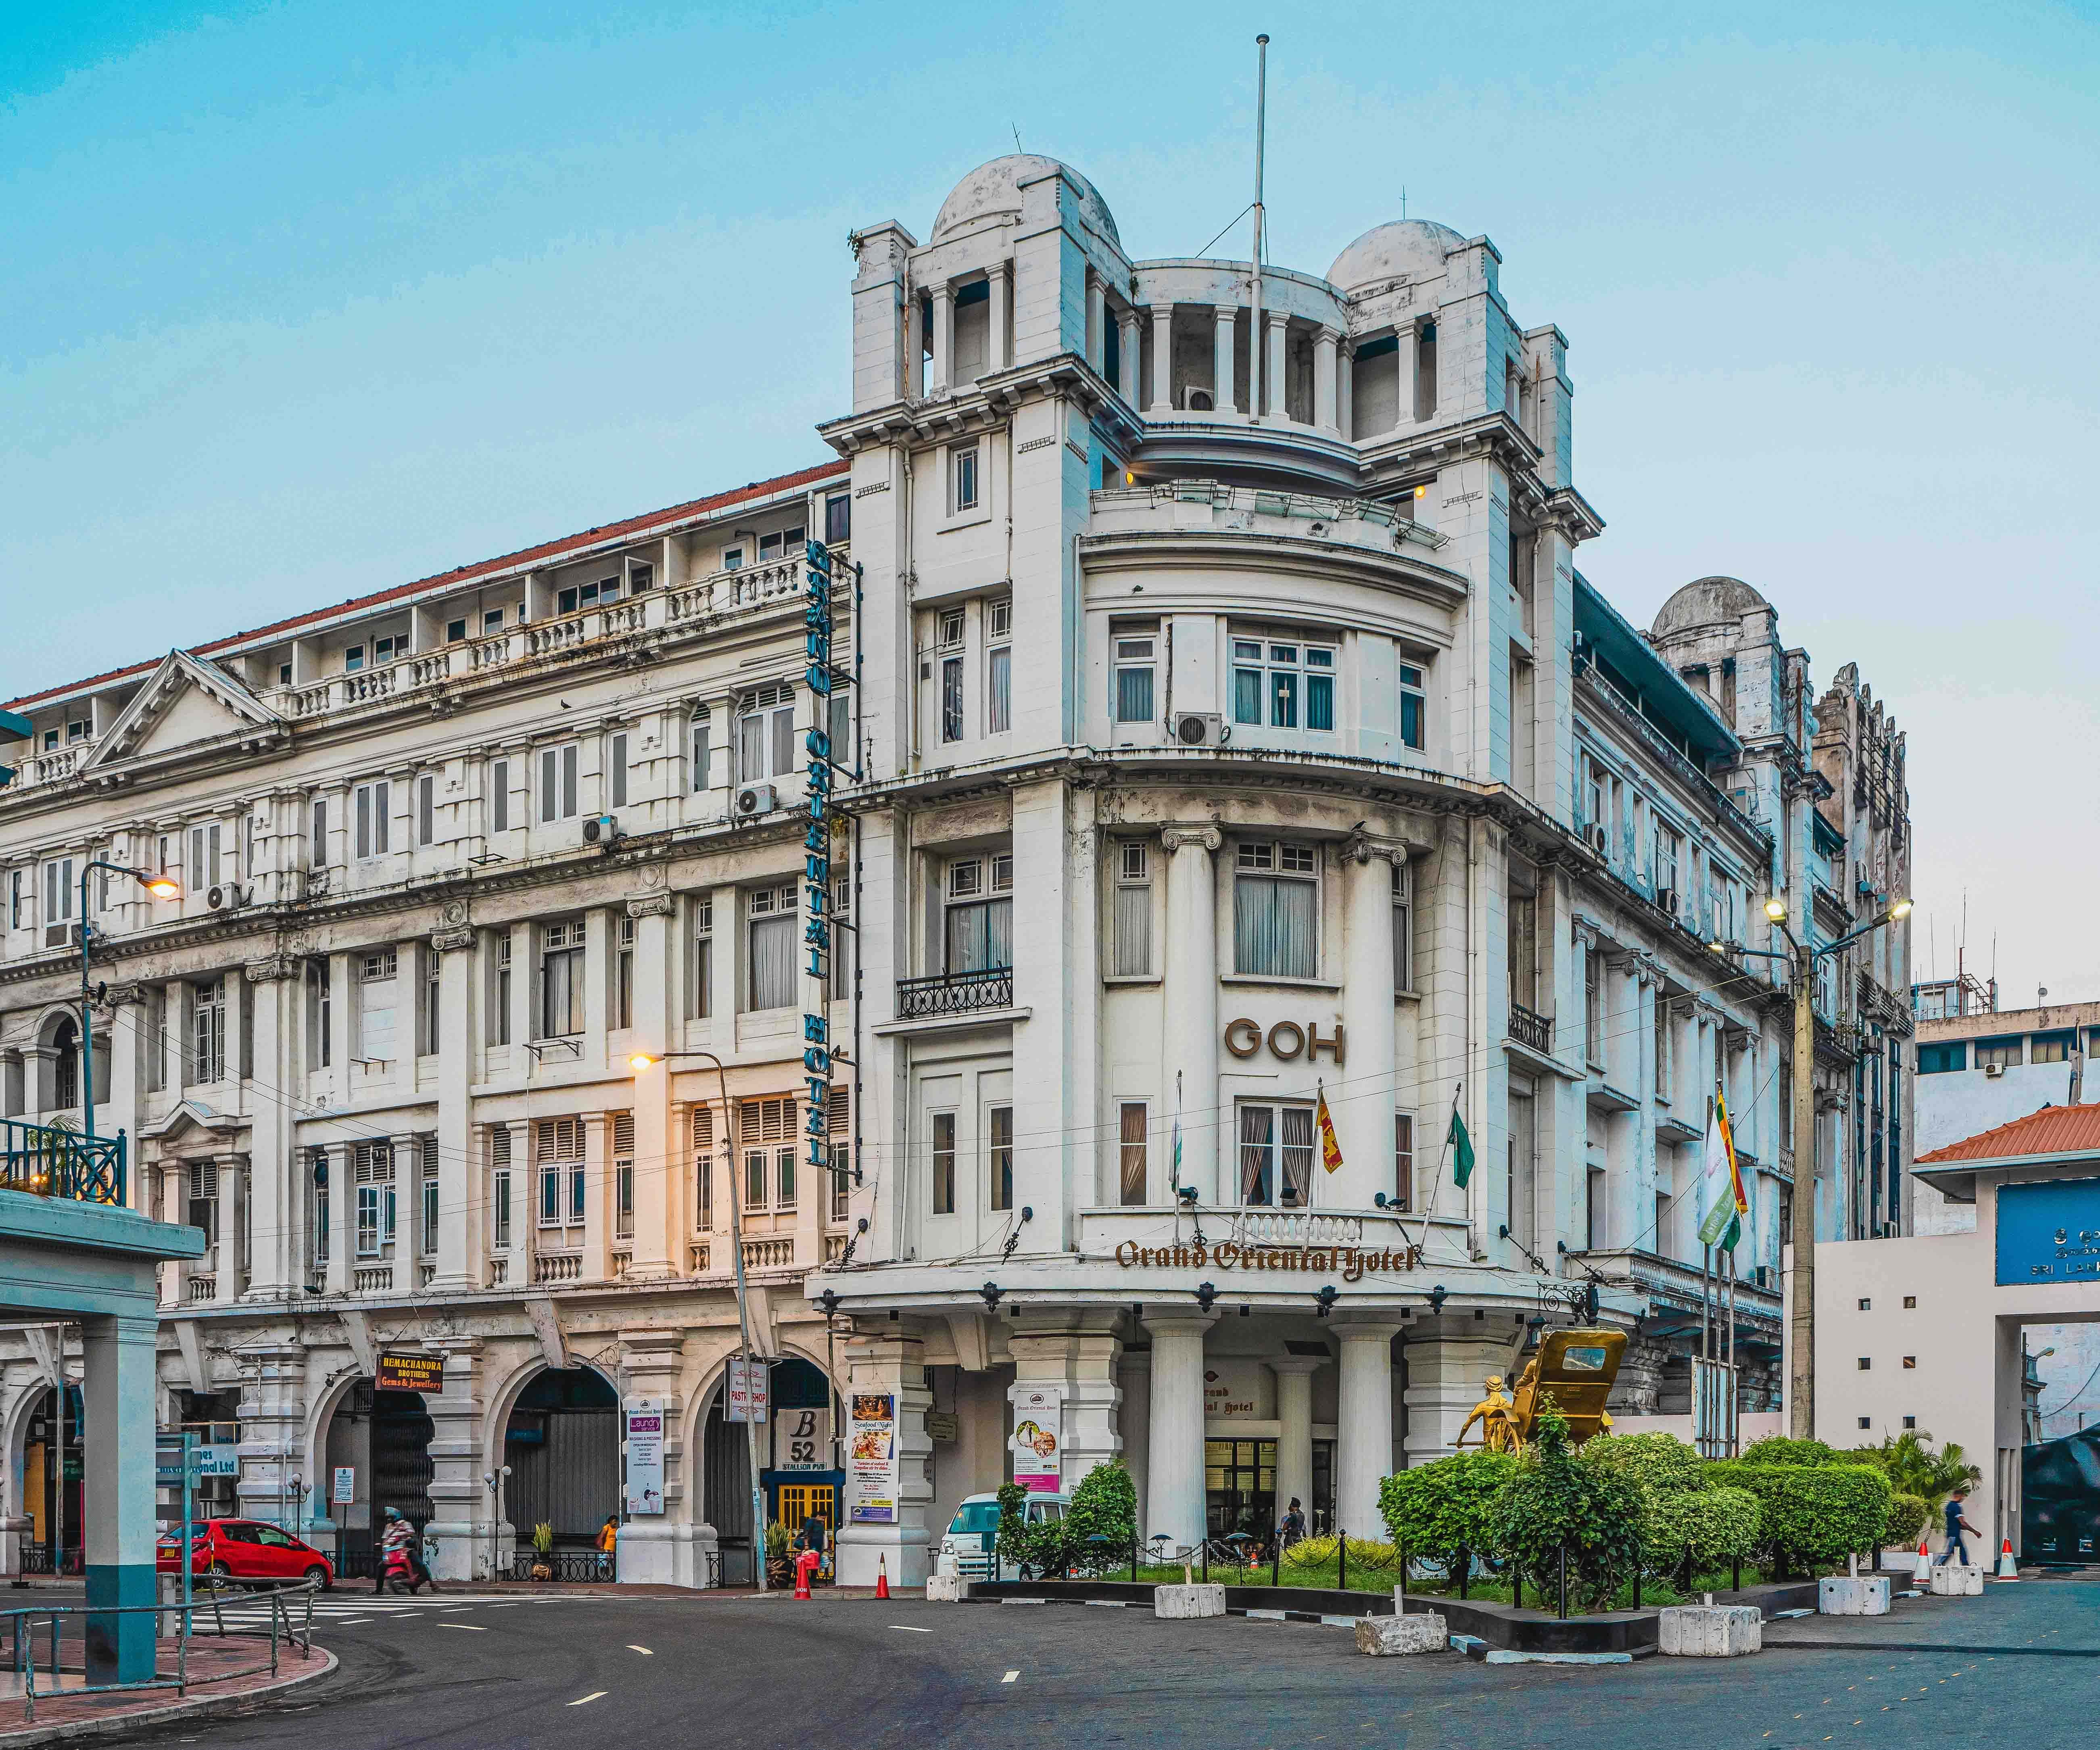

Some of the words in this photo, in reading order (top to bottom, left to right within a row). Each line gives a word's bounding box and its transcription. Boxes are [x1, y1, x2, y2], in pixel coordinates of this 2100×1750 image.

[1225, 1018, 1343, 1063] GOH
[1116, 1240, 1207, 1269] Grand
[1213, 1241, 1341, 1271] Oriental
[1343, 1245, 1414, 1282] Hotel
[2030, 1265, 2054, 1275] SRI
[384, 1357, 441, 1371] HEMACHANDRA
[398, 1370, 430, 1378] BROTHERS
[382, 1376, 401, 1386] Gems
[409, 1378, 441, 1390] Jewellery
[732, 1391, 747, 1401] PASTR
[752, 1393, 766, 1403] SHOP
[630, 1418, 660, 1429] Laundry
[790, 1411, 817, 1437] B
[855, 1421, 877, 1429] Seafood
[877, 1422, 892, 1430] Night
[791, 1441, 816, 1462] 52
[219, 1461, 234, 1472] Ltd
